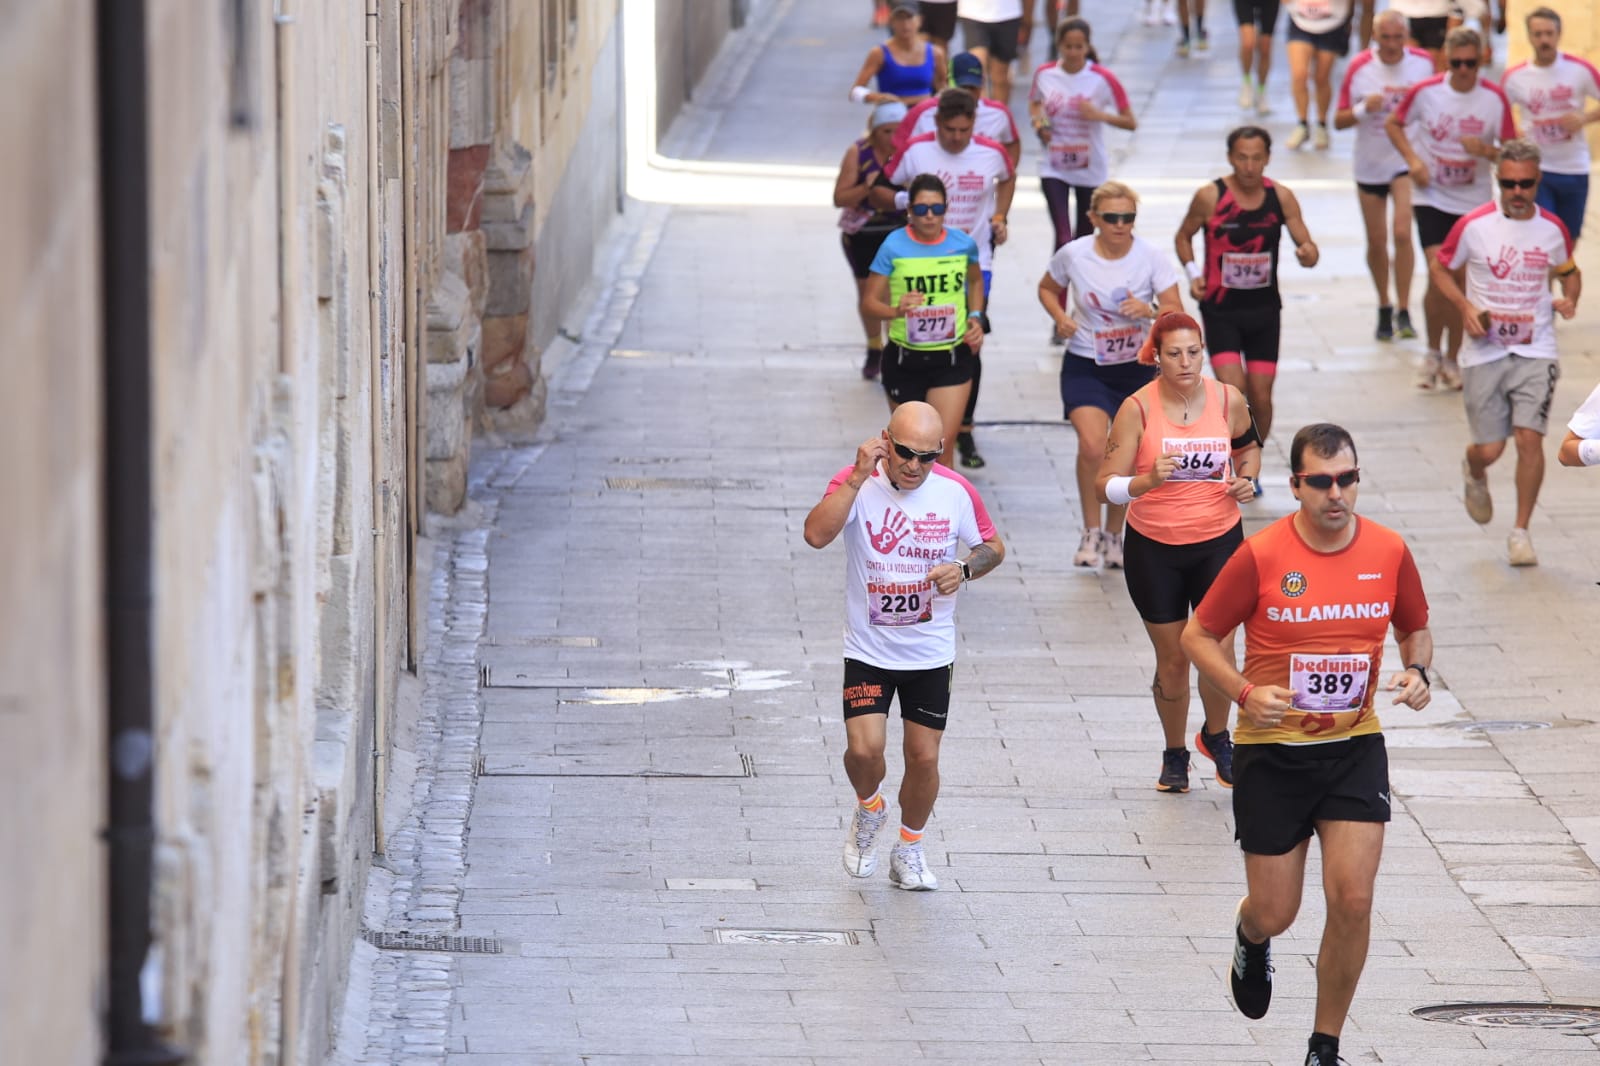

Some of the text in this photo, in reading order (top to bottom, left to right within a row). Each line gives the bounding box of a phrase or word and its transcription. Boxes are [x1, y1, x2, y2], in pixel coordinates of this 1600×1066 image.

[1233, 264, 1262, 277] 394
[917, 317, 947, 332] 277
[1498, 323, 1519, 336] 60
[1106, 336, 1135, 352] 274
[1165, 441, 1227, 452] bedunia
[1181, 453, 1214, 470] 364
[867, 580, 932, 595] bedunia
[881, 594, 920, 613] 220
[1267, 602, 1389, 622] SALAMANCA
[1293, 657, 1369, 673] bedunia
[1308, 673, 1353, 694] 389
